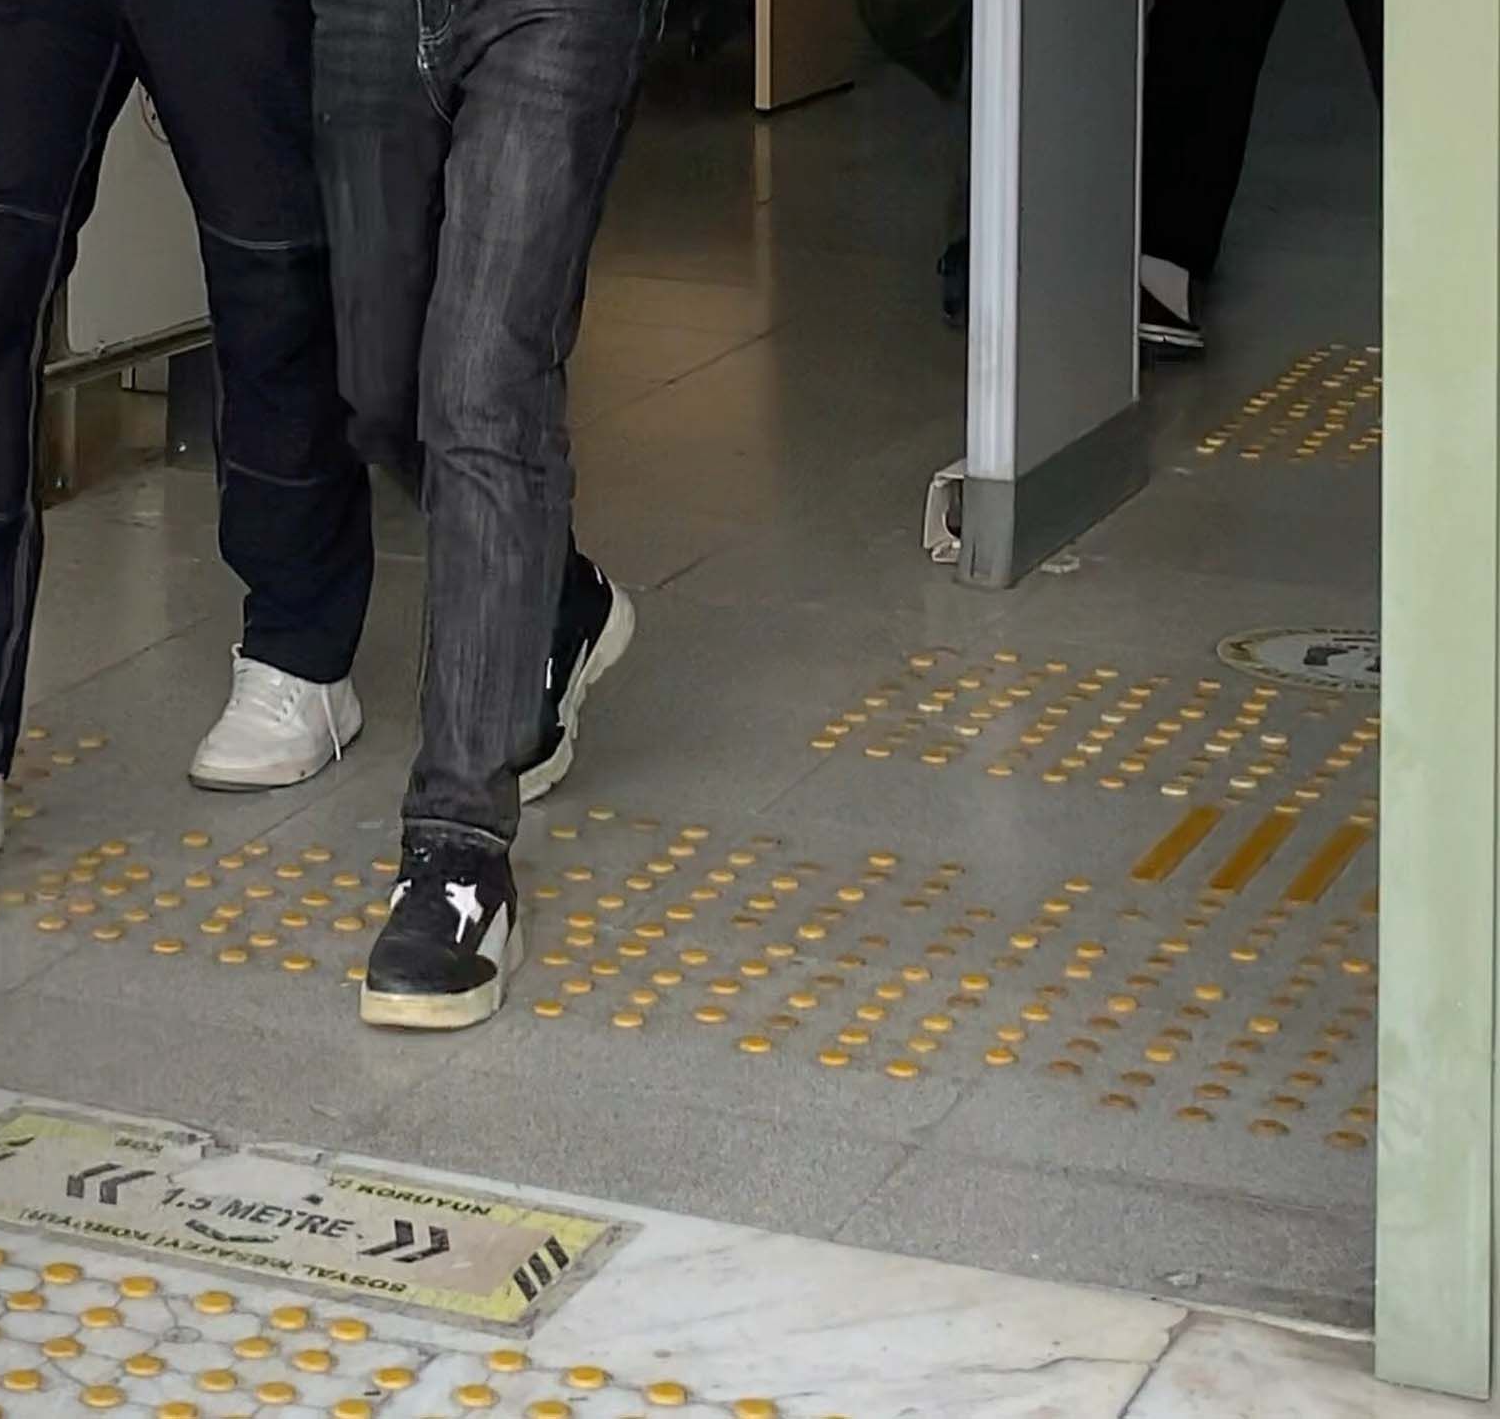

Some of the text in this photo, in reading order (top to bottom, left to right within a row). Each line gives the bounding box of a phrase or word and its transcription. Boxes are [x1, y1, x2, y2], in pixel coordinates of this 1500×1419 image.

[356, 1184, 492, 1216] KORUYUN
[217, 1198, 356, 1238] METRE
[301, 1263, 408, 1293] SOSYAL
